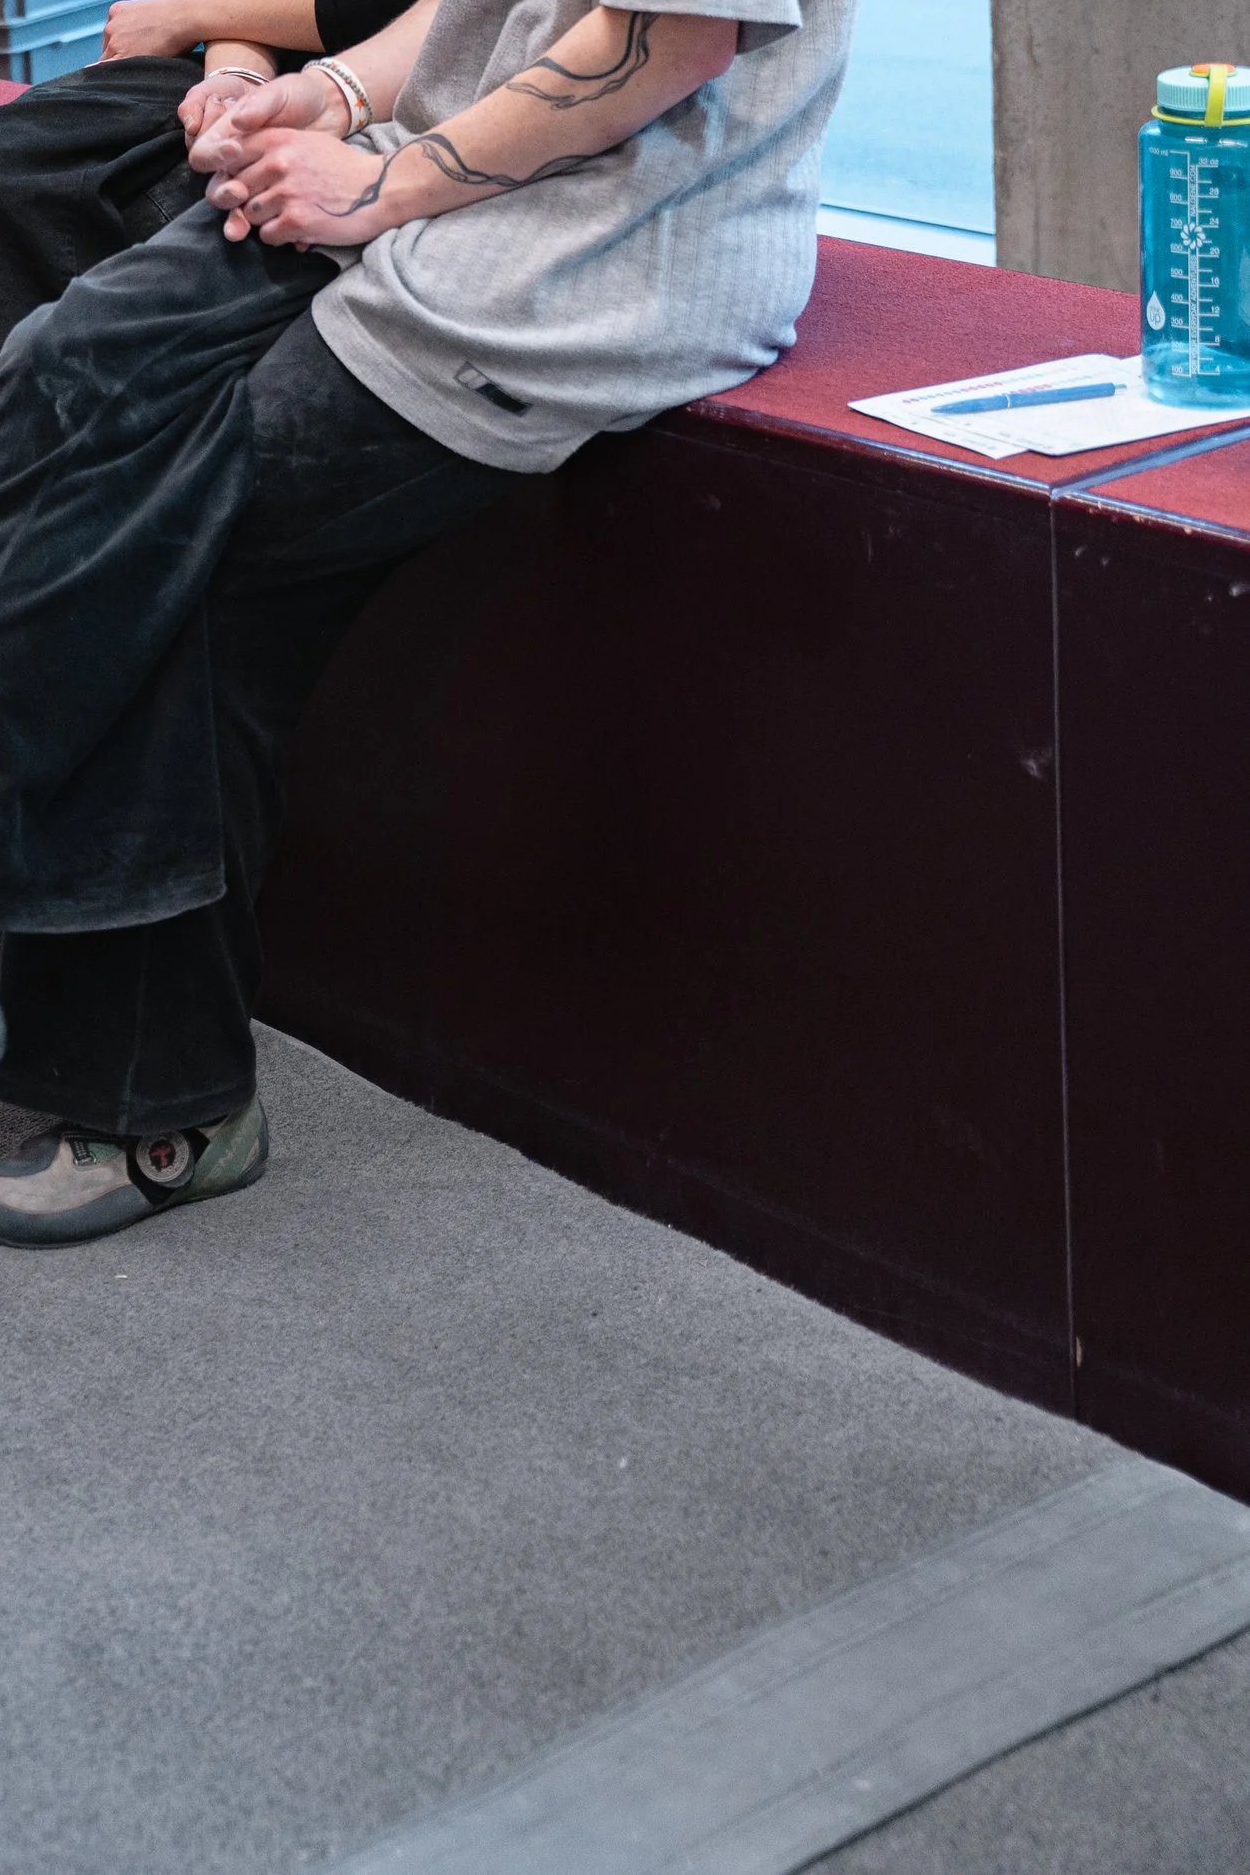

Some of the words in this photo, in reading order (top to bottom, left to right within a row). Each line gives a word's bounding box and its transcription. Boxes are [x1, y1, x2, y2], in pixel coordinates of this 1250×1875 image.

[1209, 187, 1219, 196] 28
[1170, 218, 1183, 226] 700
[1209, 217, 1219, 225] 24
[1210, 247, 1220, 255] 20
[1171, 267, 1183, 276] 500
[1211, 277, 1220, 285] 16
[1171, 293, 1183, 301] 400
[1211, 306, 1220, 314] 12
[1171, 317, 1183, 326] 300
[1214, 335, 1220, 343] 8
